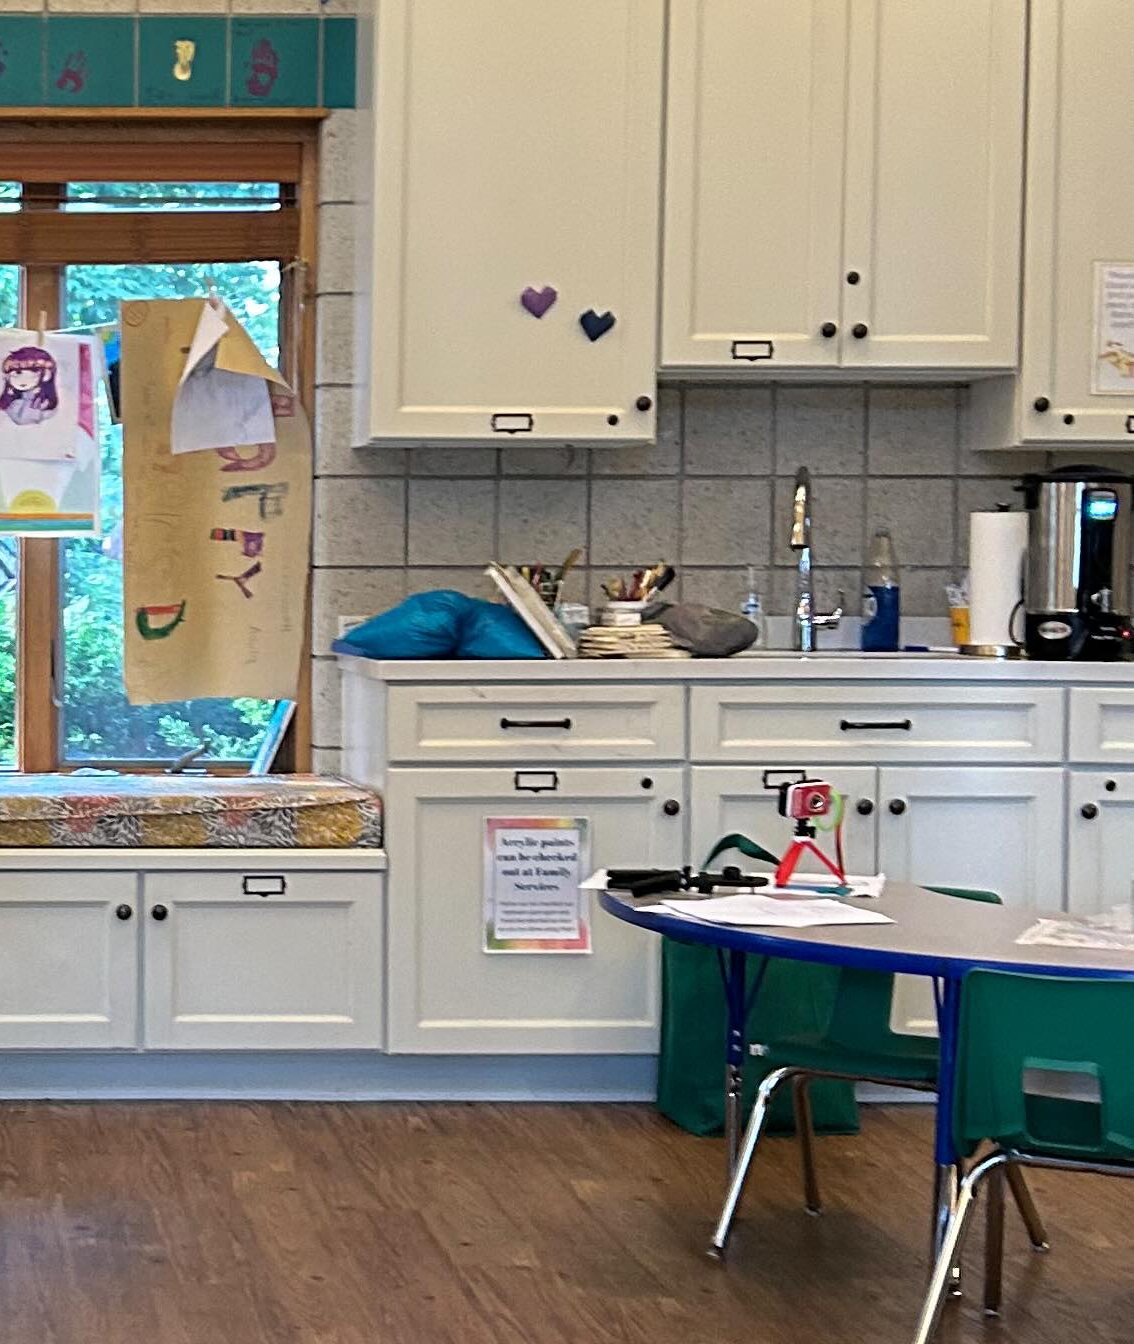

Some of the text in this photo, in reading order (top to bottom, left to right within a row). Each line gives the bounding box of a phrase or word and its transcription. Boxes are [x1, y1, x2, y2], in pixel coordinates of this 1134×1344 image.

[540, 838, 575, 848] paints
[518, 852, 531, 862] be
[532, 852, 577, 862] checked
[501, 866, 571, 878] out at Family
[514, 881, 560, 891] Services
